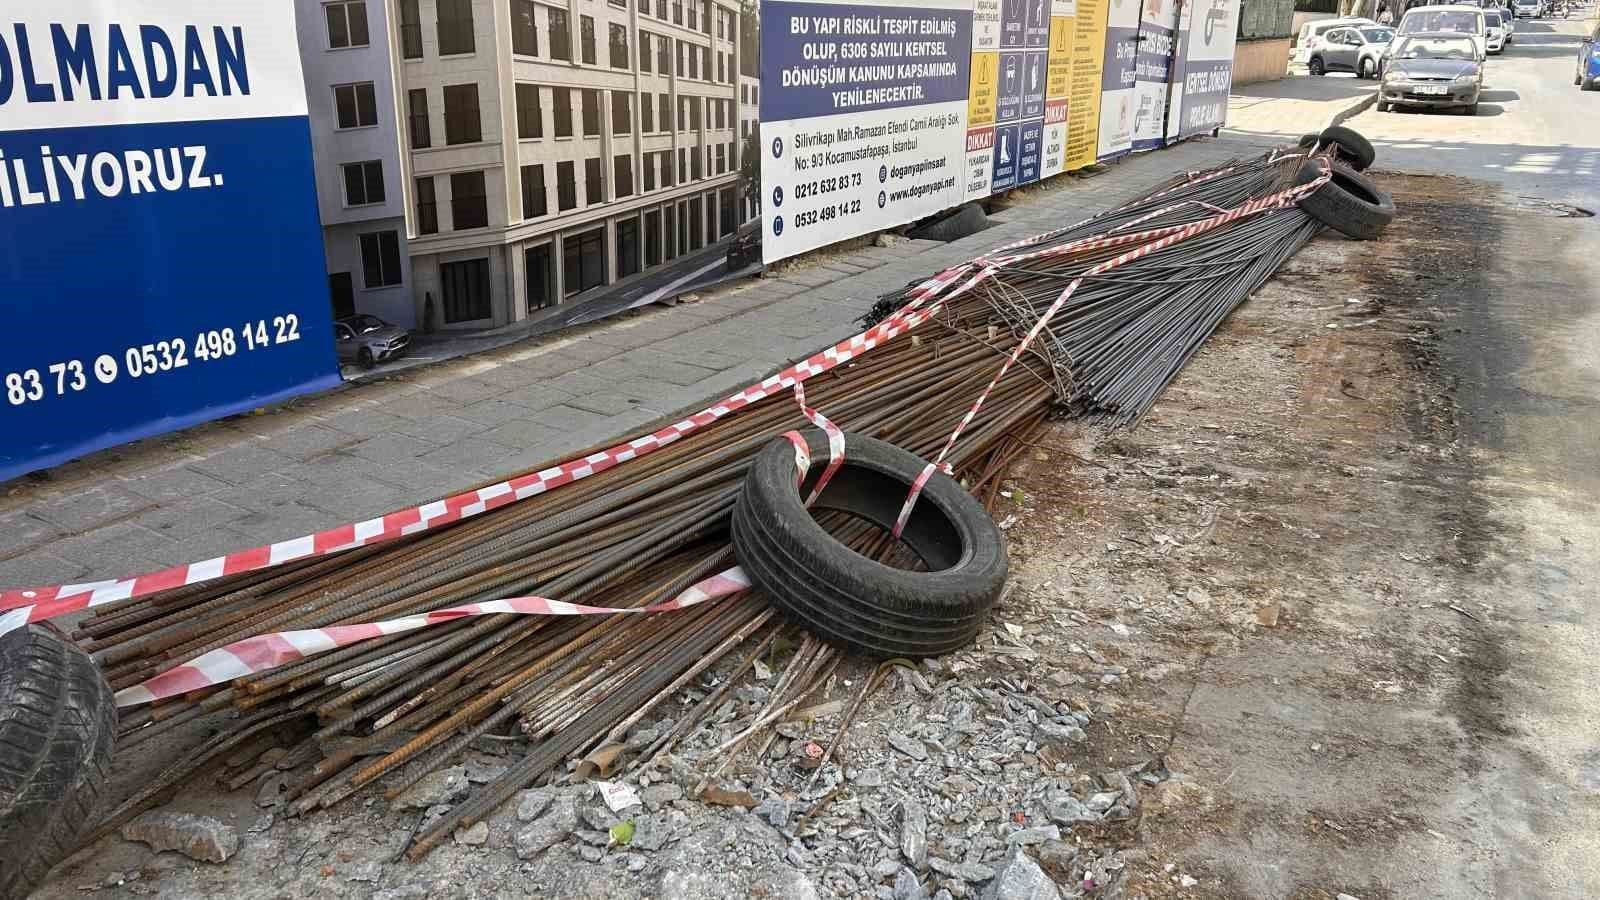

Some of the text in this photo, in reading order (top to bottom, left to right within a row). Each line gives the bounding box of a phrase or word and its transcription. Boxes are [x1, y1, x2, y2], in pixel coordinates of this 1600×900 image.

[790, 16, 808, 34] BU
[813, 16, 840, 34] YAPI
[844, 14, 880, 34] RİSKLİ
[883, 16, 918, 34] TESPİT
[920, 16, 956, 38] EDİLMİŞ
[803, 41, 947, 62] OLUP, 6306 SAYILI KENTSEL
[782, 62, 957, 88] DÖNÜŞÜM KANUNU KAPSAMINDA
[832, 82, 924, 108] YENİLENECEKTİR.
[795, 129, 835, 149] Silivrikapı
[887, 118, 909, 135] Efendi
[947, 112, 960, 126] Sok
[795, 136, 918, 171] No: 9/3 Kocamustafapaşa, İstanbul
[890, 155, 946, 180] doganyapiinsaat
[795, 172, 862, 199] 0212 632 83 73
[889, 175, 955, 202] www.doganyapi.net
[795, 199, 861, 228] 0532 498 14 22
[126, 313, 300, 378] 0532 498 14 22
[6, 359, 87, 405] 83 73
